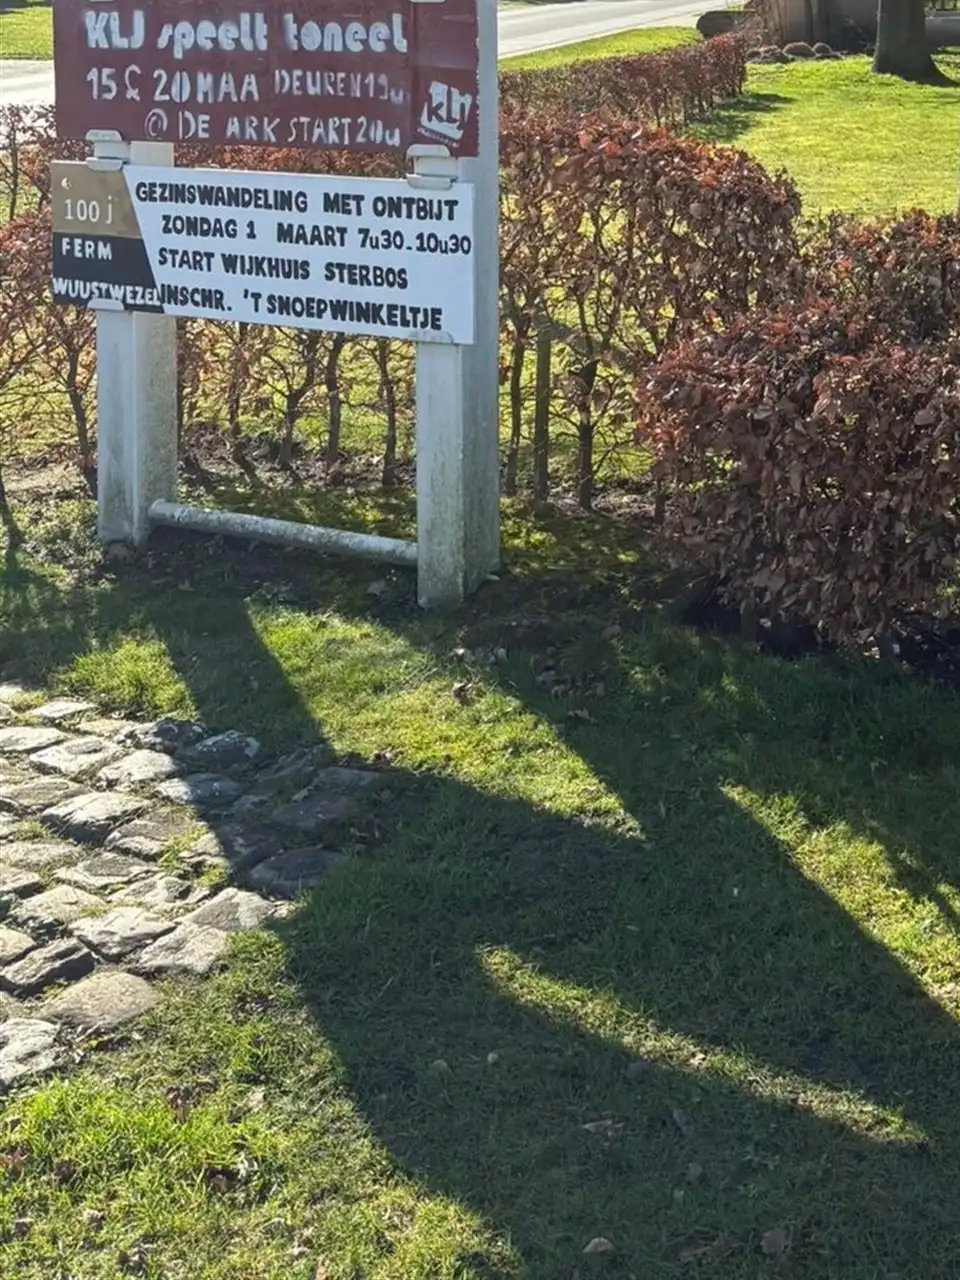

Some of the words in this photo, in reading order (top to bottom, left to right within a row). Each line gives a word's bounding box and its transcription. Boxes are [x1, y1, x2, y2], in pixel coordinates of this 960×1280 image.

[84, 10, 145, 50] KLJ
[156, 11, 269, 60] speelt
[282, 12, 408, 53] toneel
[86, 67, 117, 100] 15
[153, 69, 191, 103] 20
[275, 69, 361, 98] DEUREN
[178, 110, 210, 139] DE
[226, 116, 280, 144] ARK
[288, 115, 351, 145] START
[64, 199, 100, 222] 100
[106, 195, 113, 224] j
[135, 181, 308, 214] GEZINSWANDELING
[323, 192, 368, 217] MET
[372, 196, 459, 222] ONTBIJT
[61, 237, 113, 260] FERM
[161, 215, 238, 240] ZONDAG
[246, 223, 257, 240] 1
[277, 222, 347, 248] MAART
[158, 247, 215, 273] START
[220, 254, 311, 281] WIJKHUIS
[324, 263, 408, 290] STERBOS
[53, 277, 161, 306] WUUSTWEZEL
[266, 294, 442, 331] SNOEPWINKELTJE
